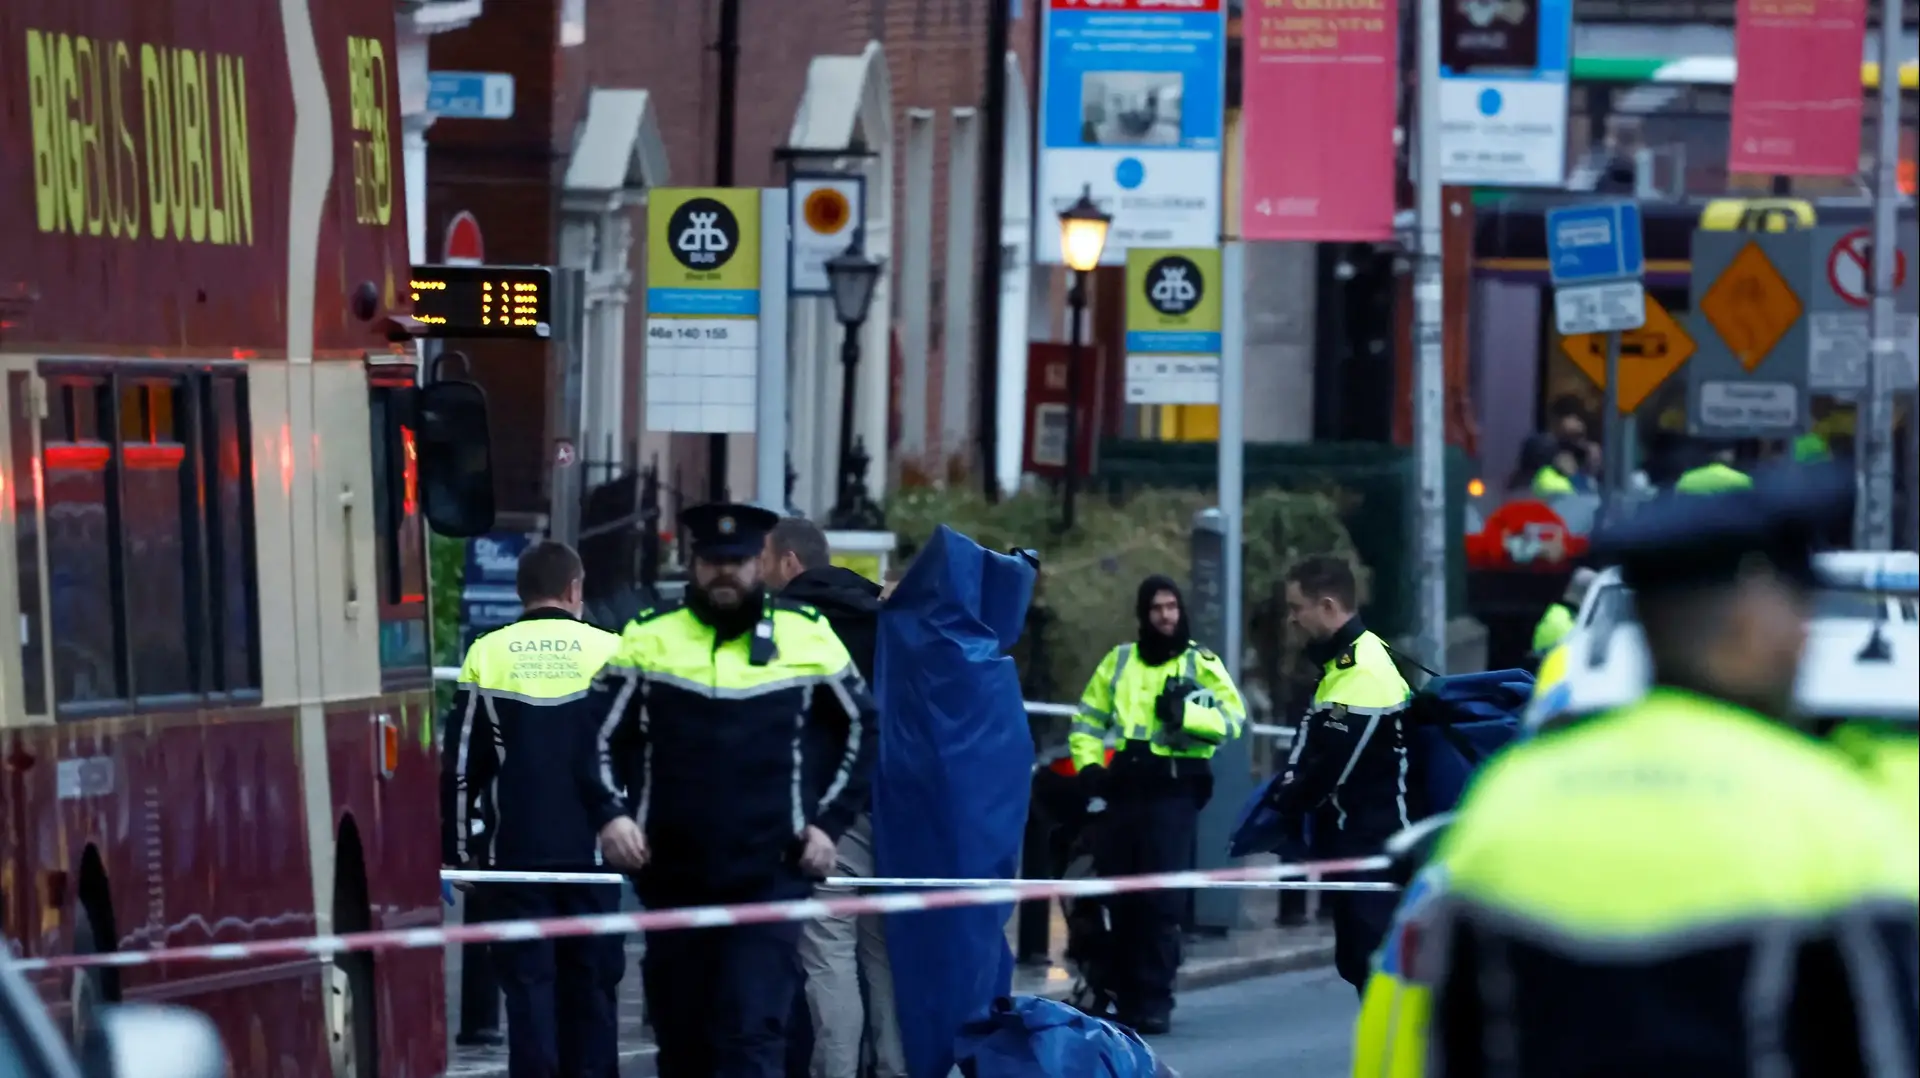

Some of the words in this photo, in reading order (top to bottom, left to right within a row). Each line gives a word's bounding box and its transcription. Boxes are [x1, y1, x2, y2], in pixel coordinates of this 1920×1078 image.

[140, 42, 253, 247] DUBLIN
[689, 252, 717, 264] BUS
[677, 328, 700, 340] 140
[508, 639, 583, 653] GARDA
[518, 652, 573, 662] DIVISIONAL
[512, 661, 543, 671] CRIME
[546, 661, 579, 671] SCENE
[509, 670, 583, 680] INVESTIGATION
